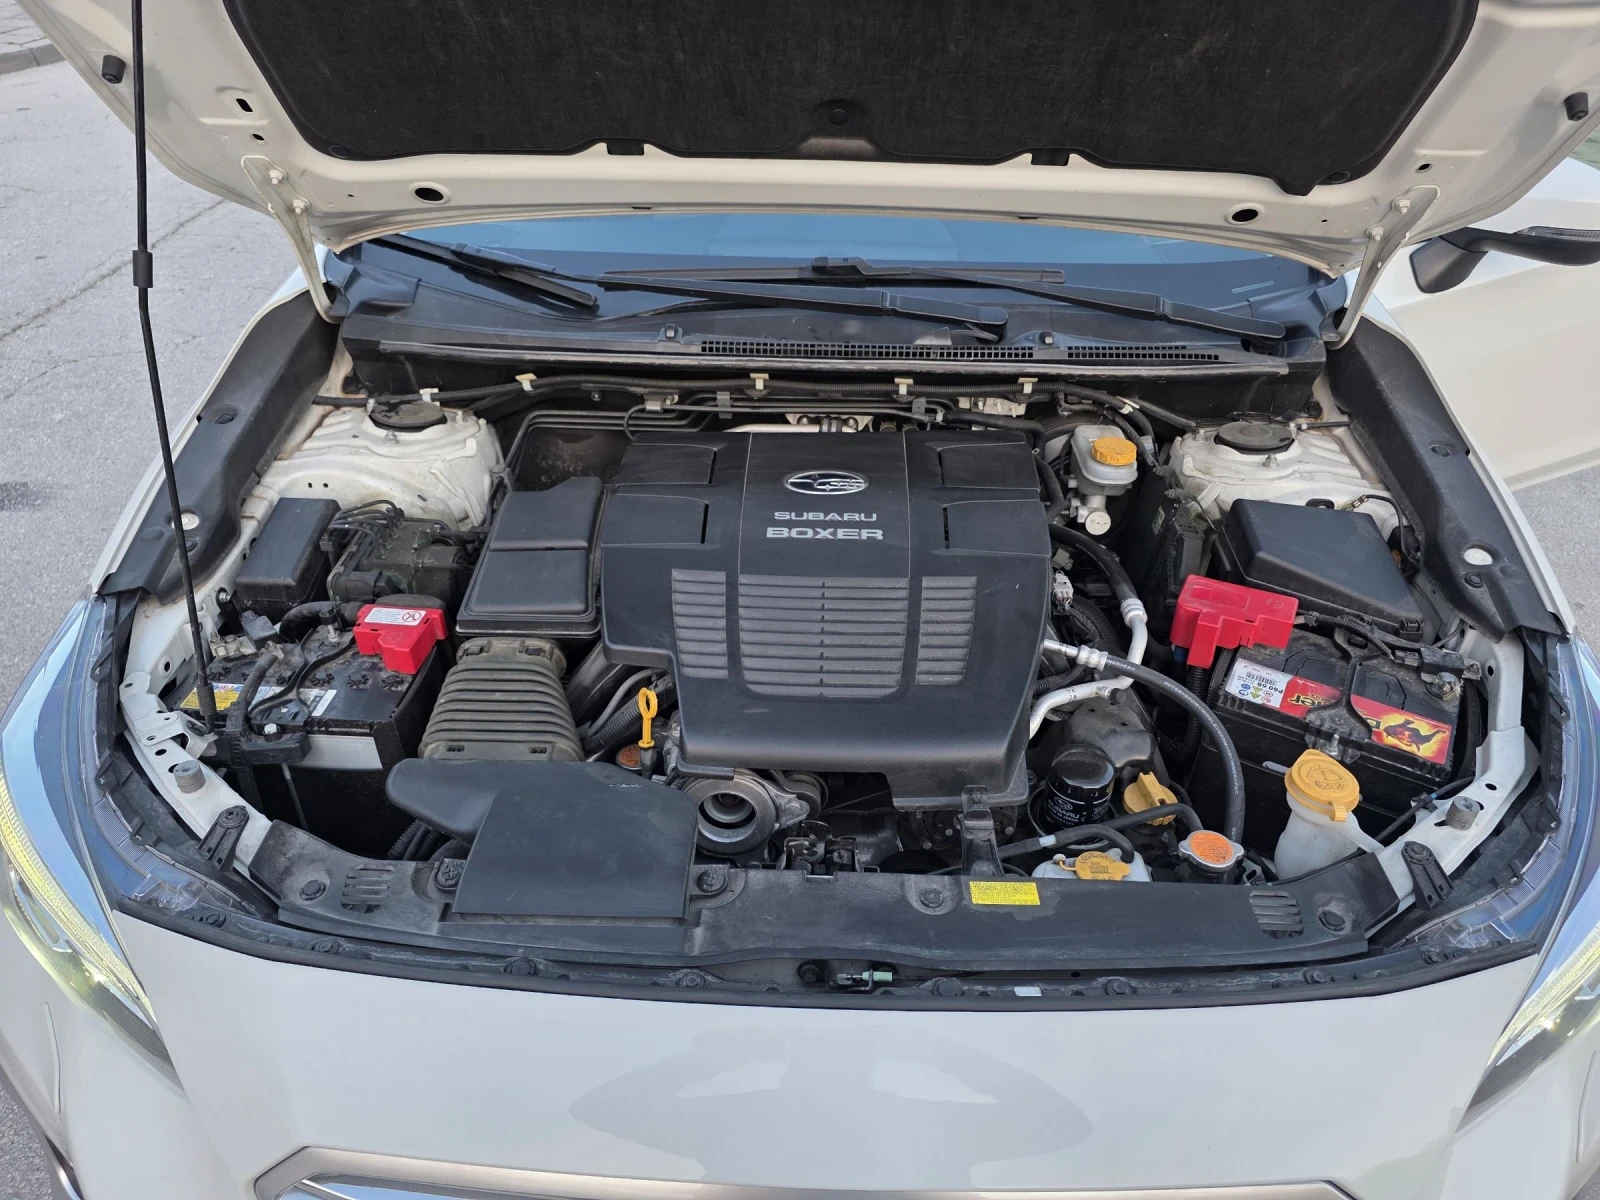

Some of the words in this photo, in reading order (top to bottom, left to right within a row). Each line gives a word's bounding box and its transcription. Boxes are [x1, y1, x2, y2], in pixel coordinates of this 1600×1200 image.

[773, 511, 877, 522] SUBARU
[766, 527, 884, 540] BOXER
[1268, 685, 1284, 694] P60
